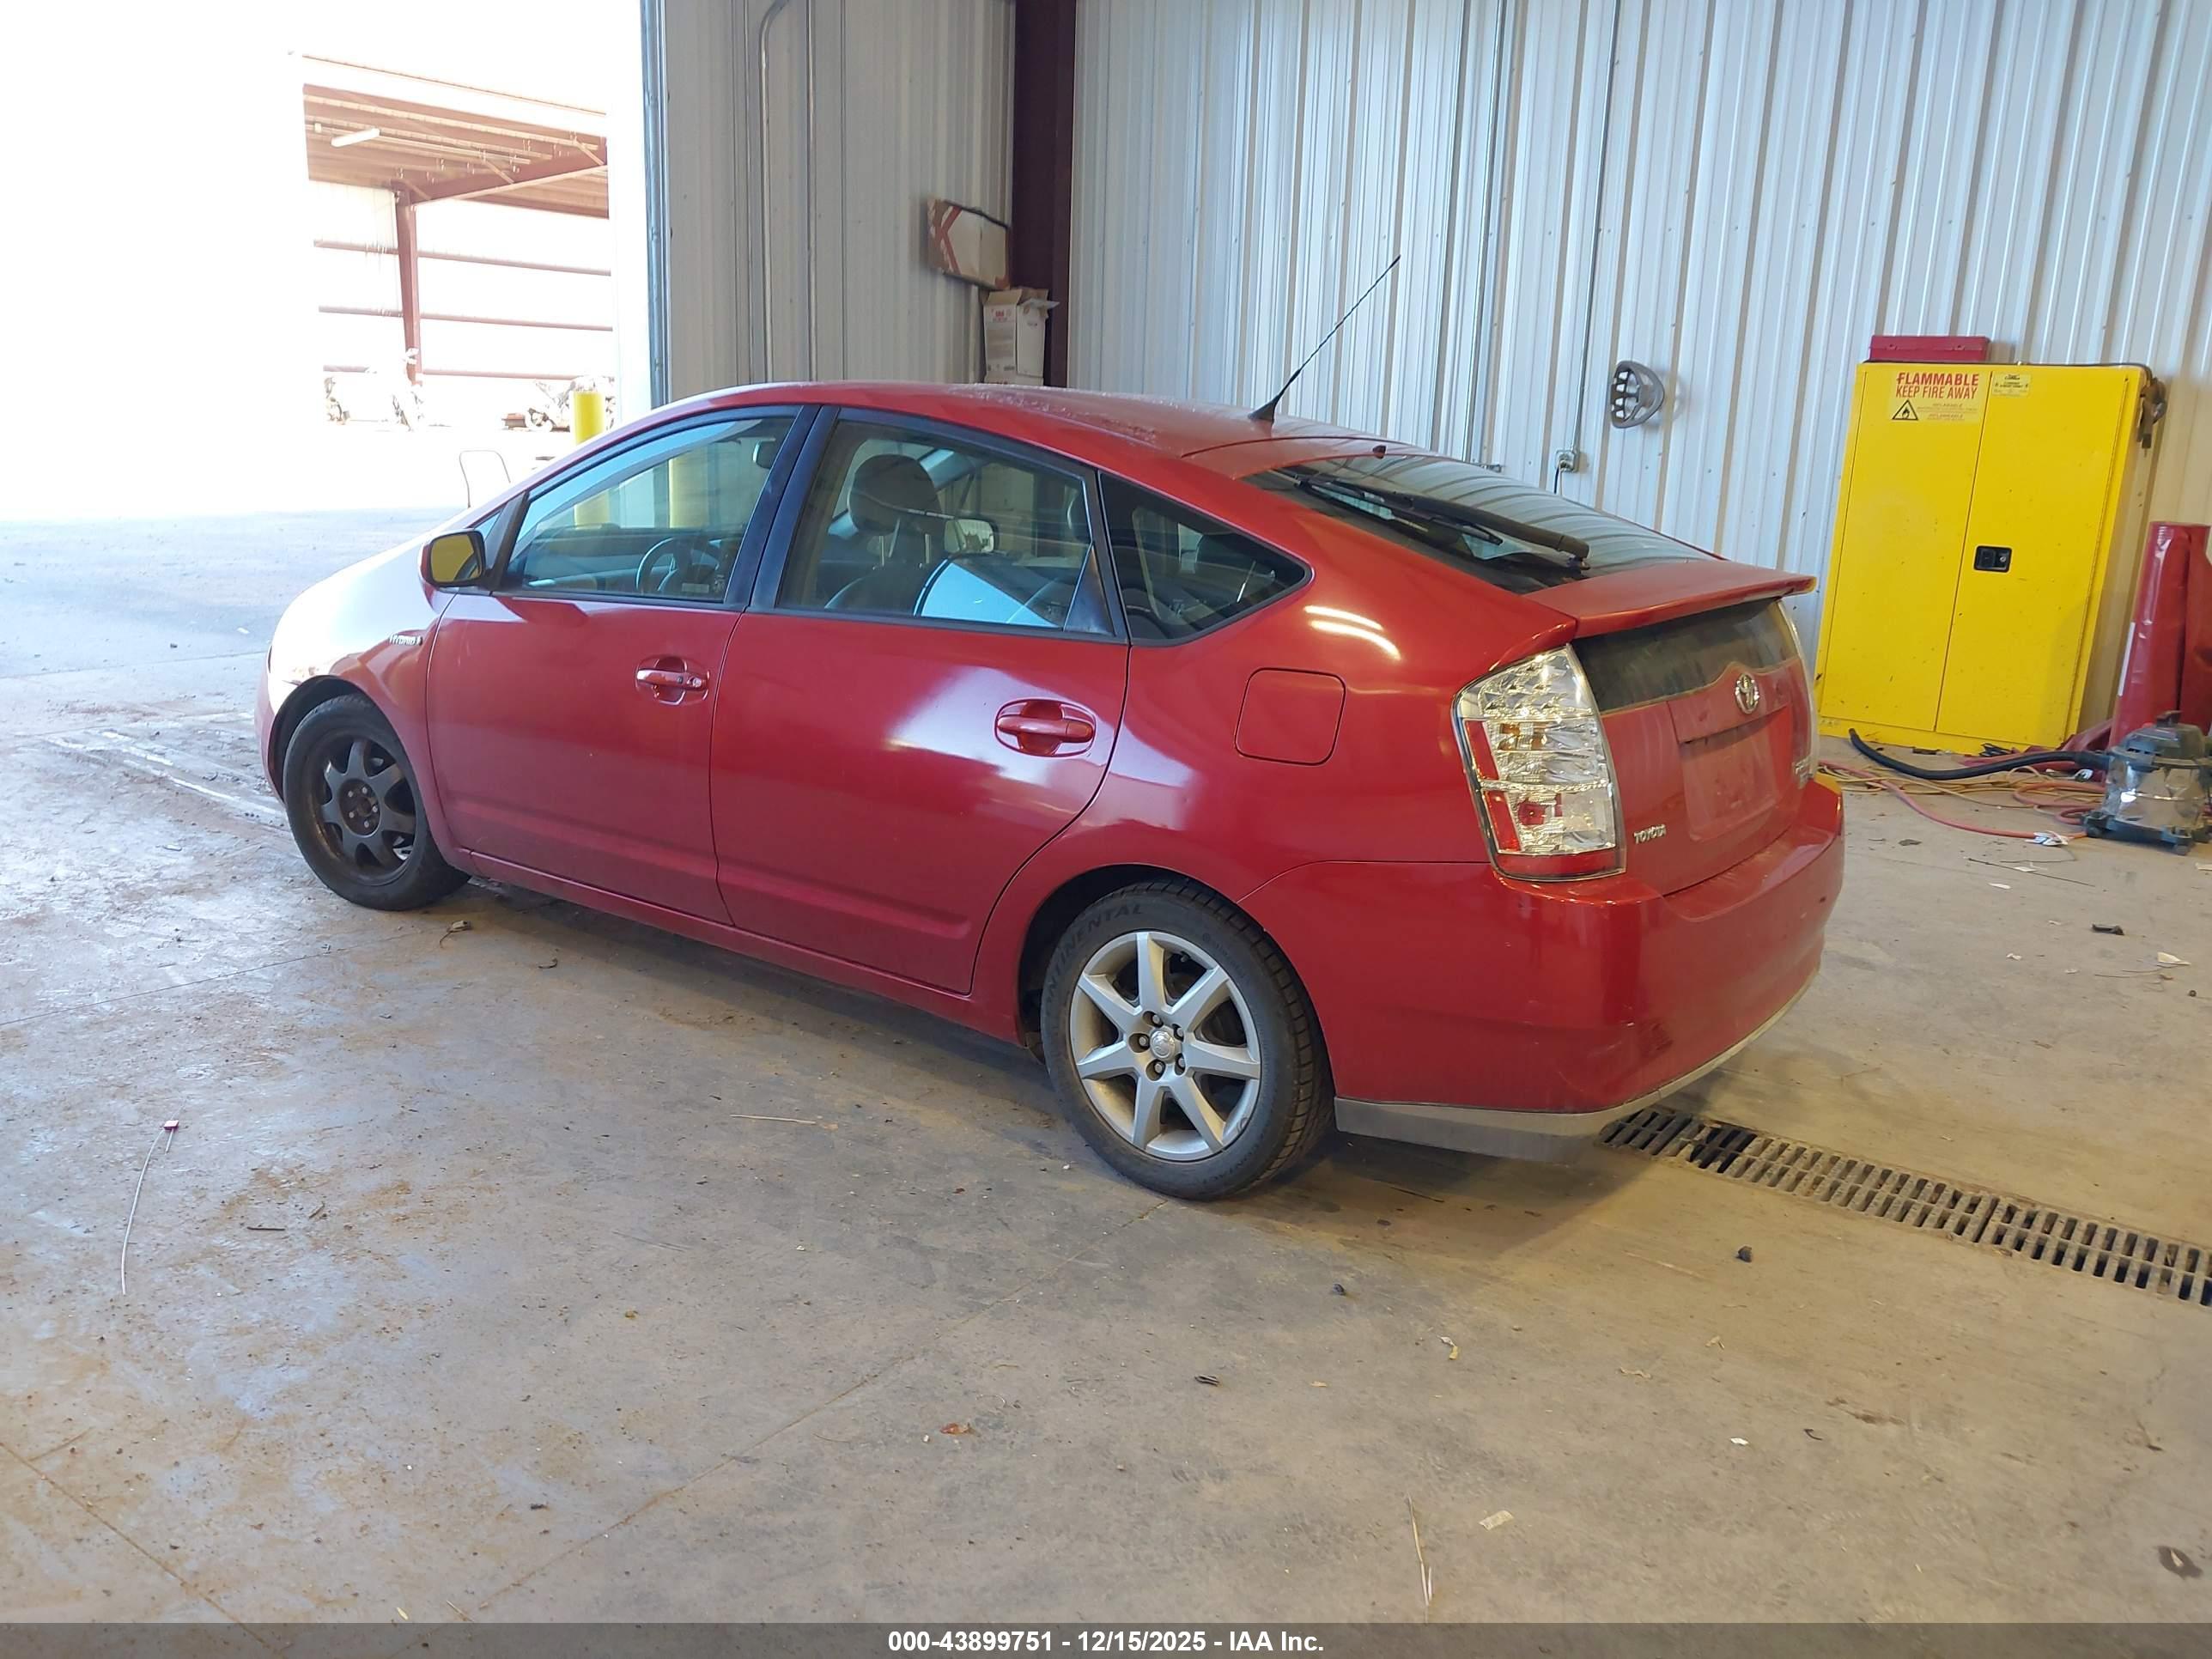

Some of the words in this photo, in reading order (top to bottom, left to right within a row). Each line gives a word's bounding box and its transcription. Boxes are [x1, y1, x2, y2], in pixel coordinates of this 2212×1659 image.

[1896, 372, 1979, 386] FLAMMABLE
[1895, 385, 1920, 398] KEEP
[1923, 386, 1945, 399] FIRE
[1947, 386, 1978, 399] AWAY
[1633, 824, 1667, 845] TOYOTA
